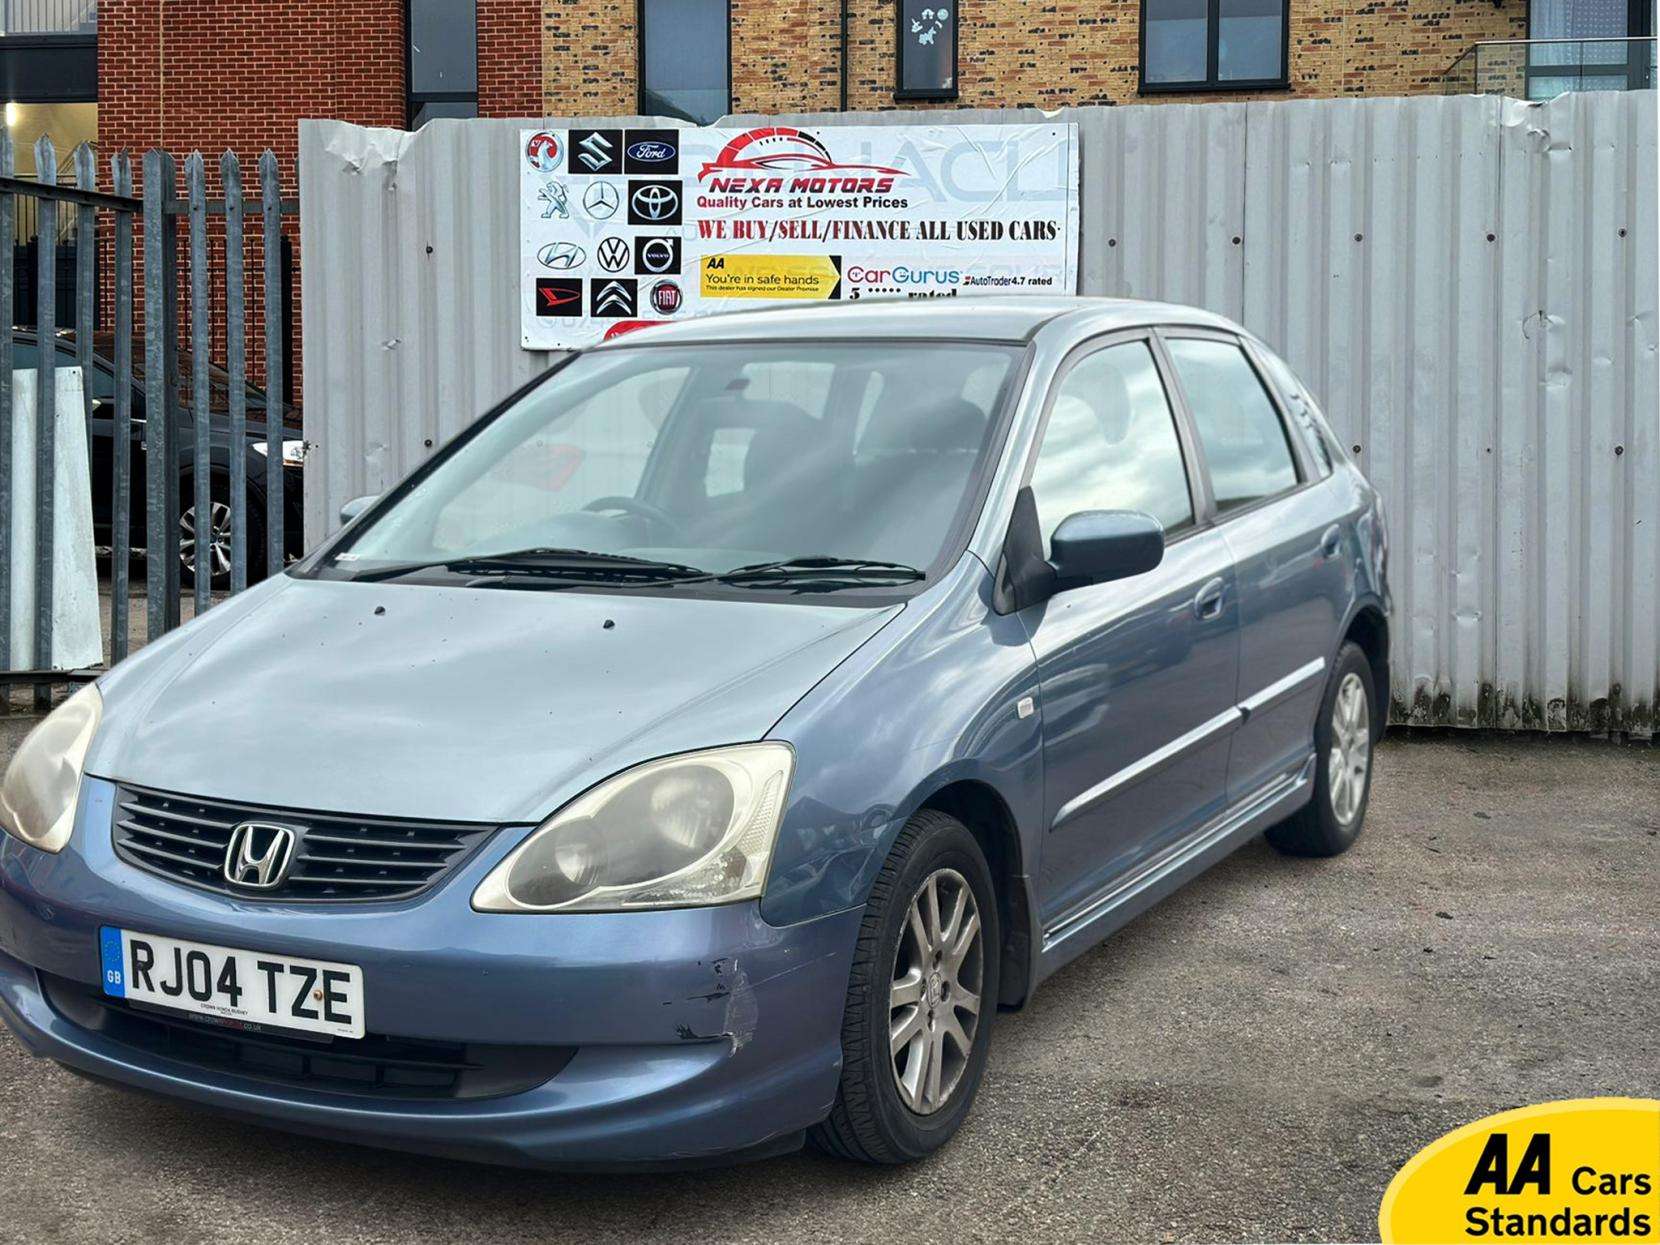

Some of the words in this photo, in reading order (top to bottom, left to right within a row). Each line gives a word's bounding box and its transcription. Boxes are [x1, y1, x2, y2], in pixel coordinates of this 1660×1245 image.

[636, 145, 666, 158] Ford
[709, 178, 783, 193] NEXA
[789, 178, 895, 193] MOTORS
[697, 196, 746, 210] Quality
[751, 196, 784, 208] Cars
[788, 197, 803, 208] at
[807, 196, 859, 208] Lowest
[863, 196, 908, 208] Prices
[697, 220, 727, 240] WE
[733, 220, 911, 242] BUY/SELL/FINANCE
[916, 220, 951, 240] ALL
[957, 220, 1004, 240] USED
[1009, 220, 1057, 240] CARS
[707, 257, 724, 269] AA
[706, 274, 741, 284] You're
[744, 274, 754, 284] in
[757, 273, 781, 284] safe
[784, 275, 819, 285] hands
[847, 266, 960, 284] CarGurus
[1011, 276, 1026, 286] 4.7
[1028, 276, 1052, 286] rated
[658, 290, 677, 306] FIAT
[849, 287, 861, 300] 5
[106, 970, 122, 985] GB
[130, 939, 243, 1008] RJ04
[257, 960, 352, 1025] TZE
